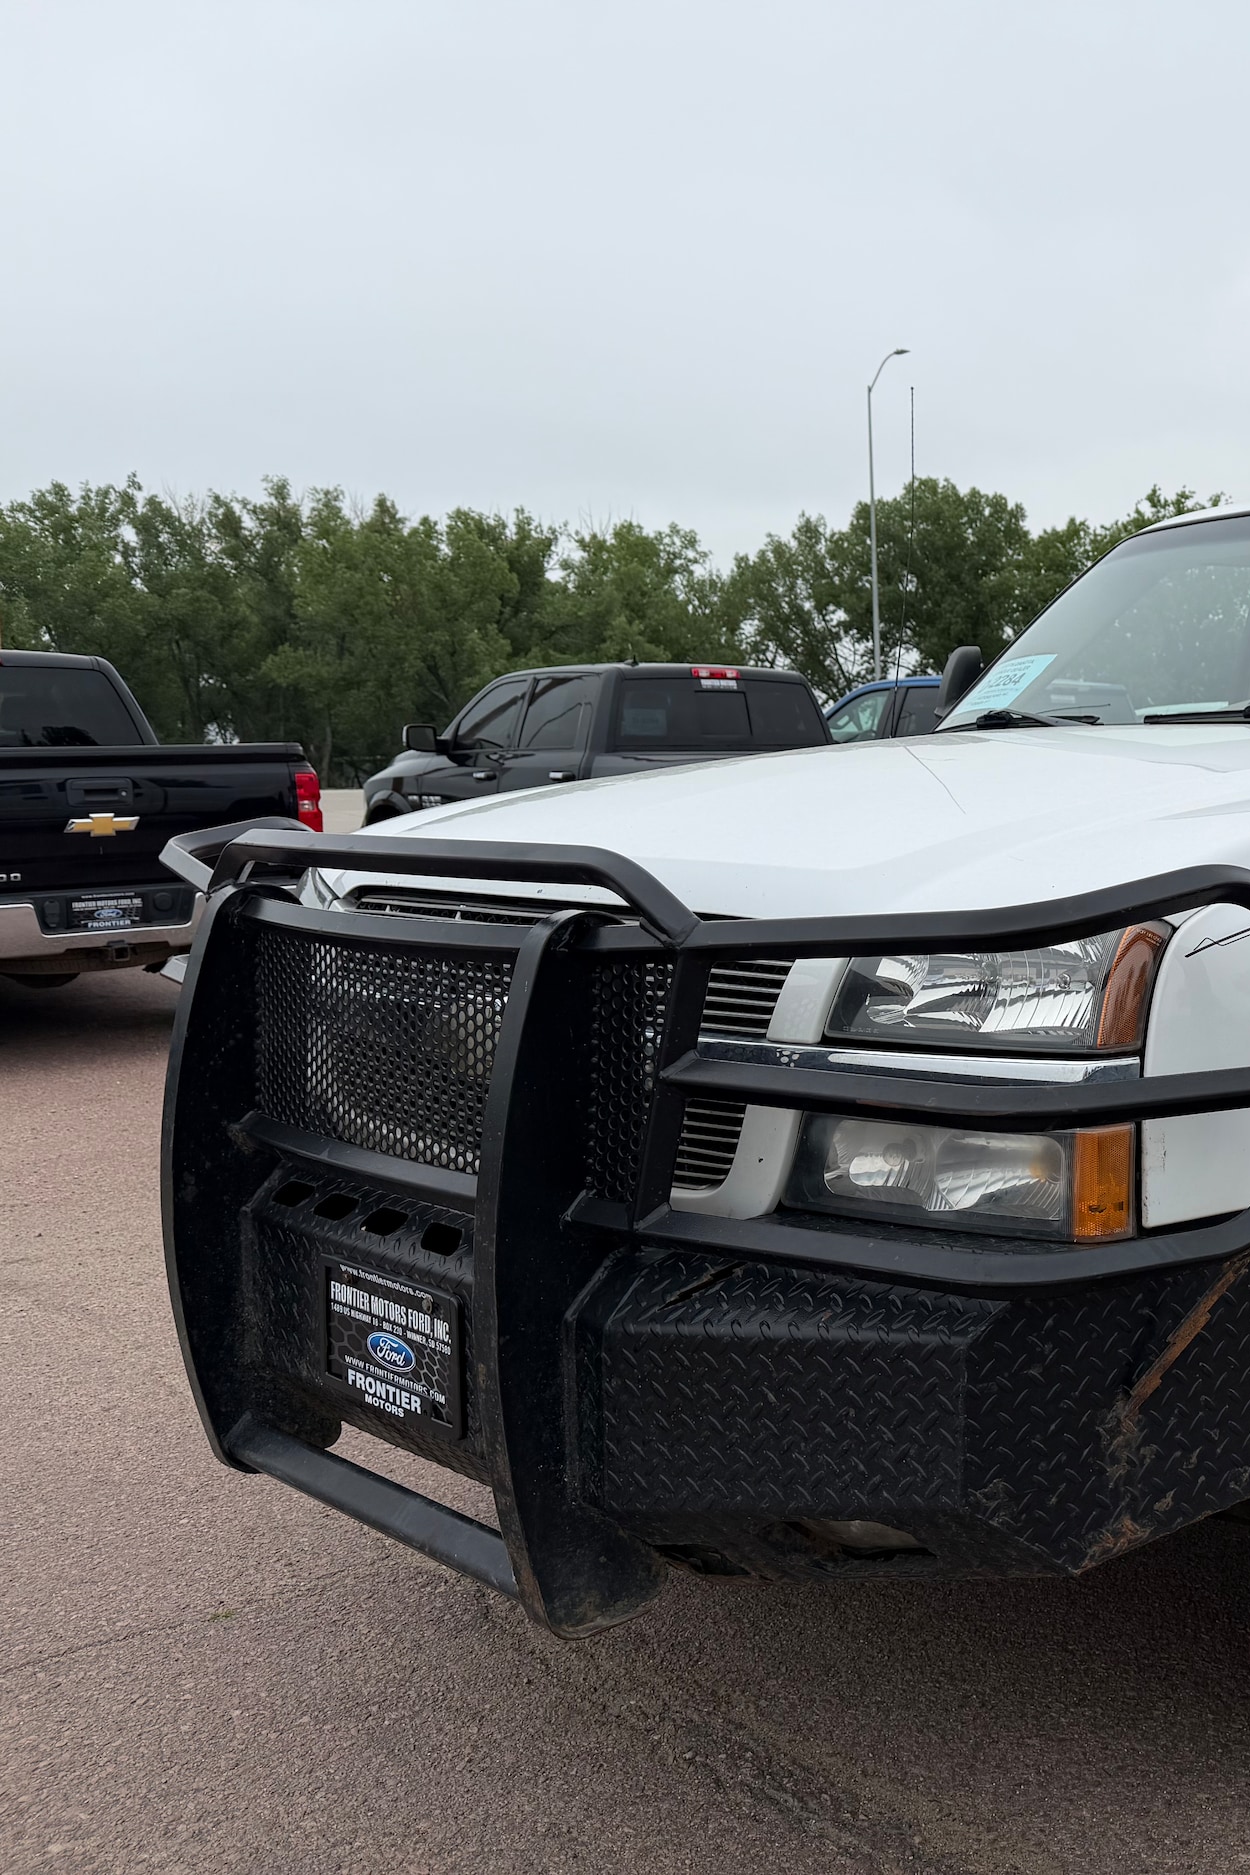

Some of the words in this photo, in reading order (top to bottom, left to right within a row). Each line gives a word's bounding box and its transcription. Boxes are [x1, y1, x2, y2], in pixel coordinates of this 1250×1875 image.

[88, 919, 131, 928] FRONTIER
[331, 1281, 370, 1312] FRONTIER
[371, 1295, 407, 1326] MOTORS
[408, 1309, 433, 1338] FORD,
[434, 1318, 452, 1344] INC.
[376, 1338, 406, 1367] Ford
[347, 1368, 422, 1415] FRONTIER
[365, 1393, 405, 1418] MOTORS
